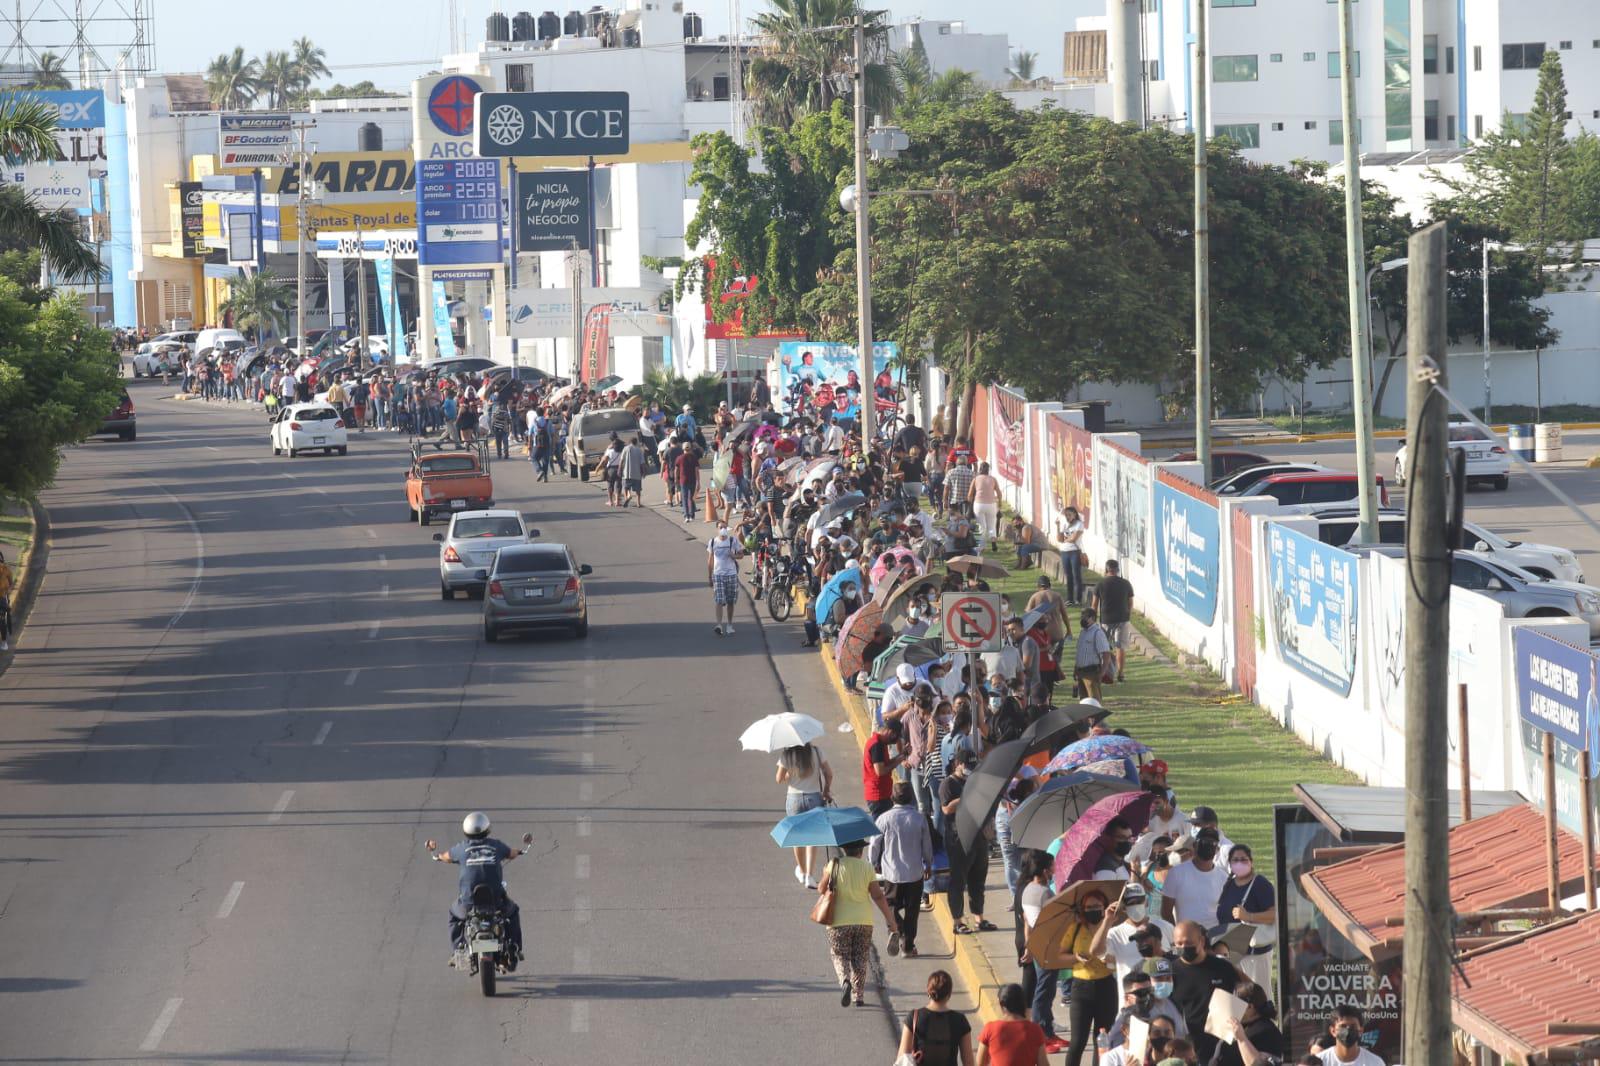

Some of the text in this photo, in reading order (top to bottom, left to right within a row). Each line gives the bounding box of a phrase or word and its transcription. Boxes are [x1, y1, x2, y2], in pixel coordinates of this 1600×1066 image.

[530, 110, 623, 139] NICE
[225, 135, 289, 144] BFGoodrich
[429, 142, 473, 158] ARC
[455, 162, 496, 178] 20.89
[33, 187, 81, 196] CEMEQ
[455, 182, 496, 198] 22.59
[536, 183, 569, 194] INICIA
[462, 203, 497, 219] 17.00
[525, 194, 580, 214] tu propio
[353, 212, 390, 228] Royal
[394, 212, 409, 224] de
[528, 214, 580, 225] NEGOCIO
[337, 239, 363, 254] ARC
[383, 238, 416, 254] ARCO
[1529, 652, 1579, 700] LOS MEJORES TENIS
[1530, 690, 1580, 736] LAS MEJORES MARCAS
[1323, 962, 1369, 972] VACÚNATE
[1301, 975, 1393, 991] VOLVER A
[1297, 993, 1398, 1010] TRABAJAR
